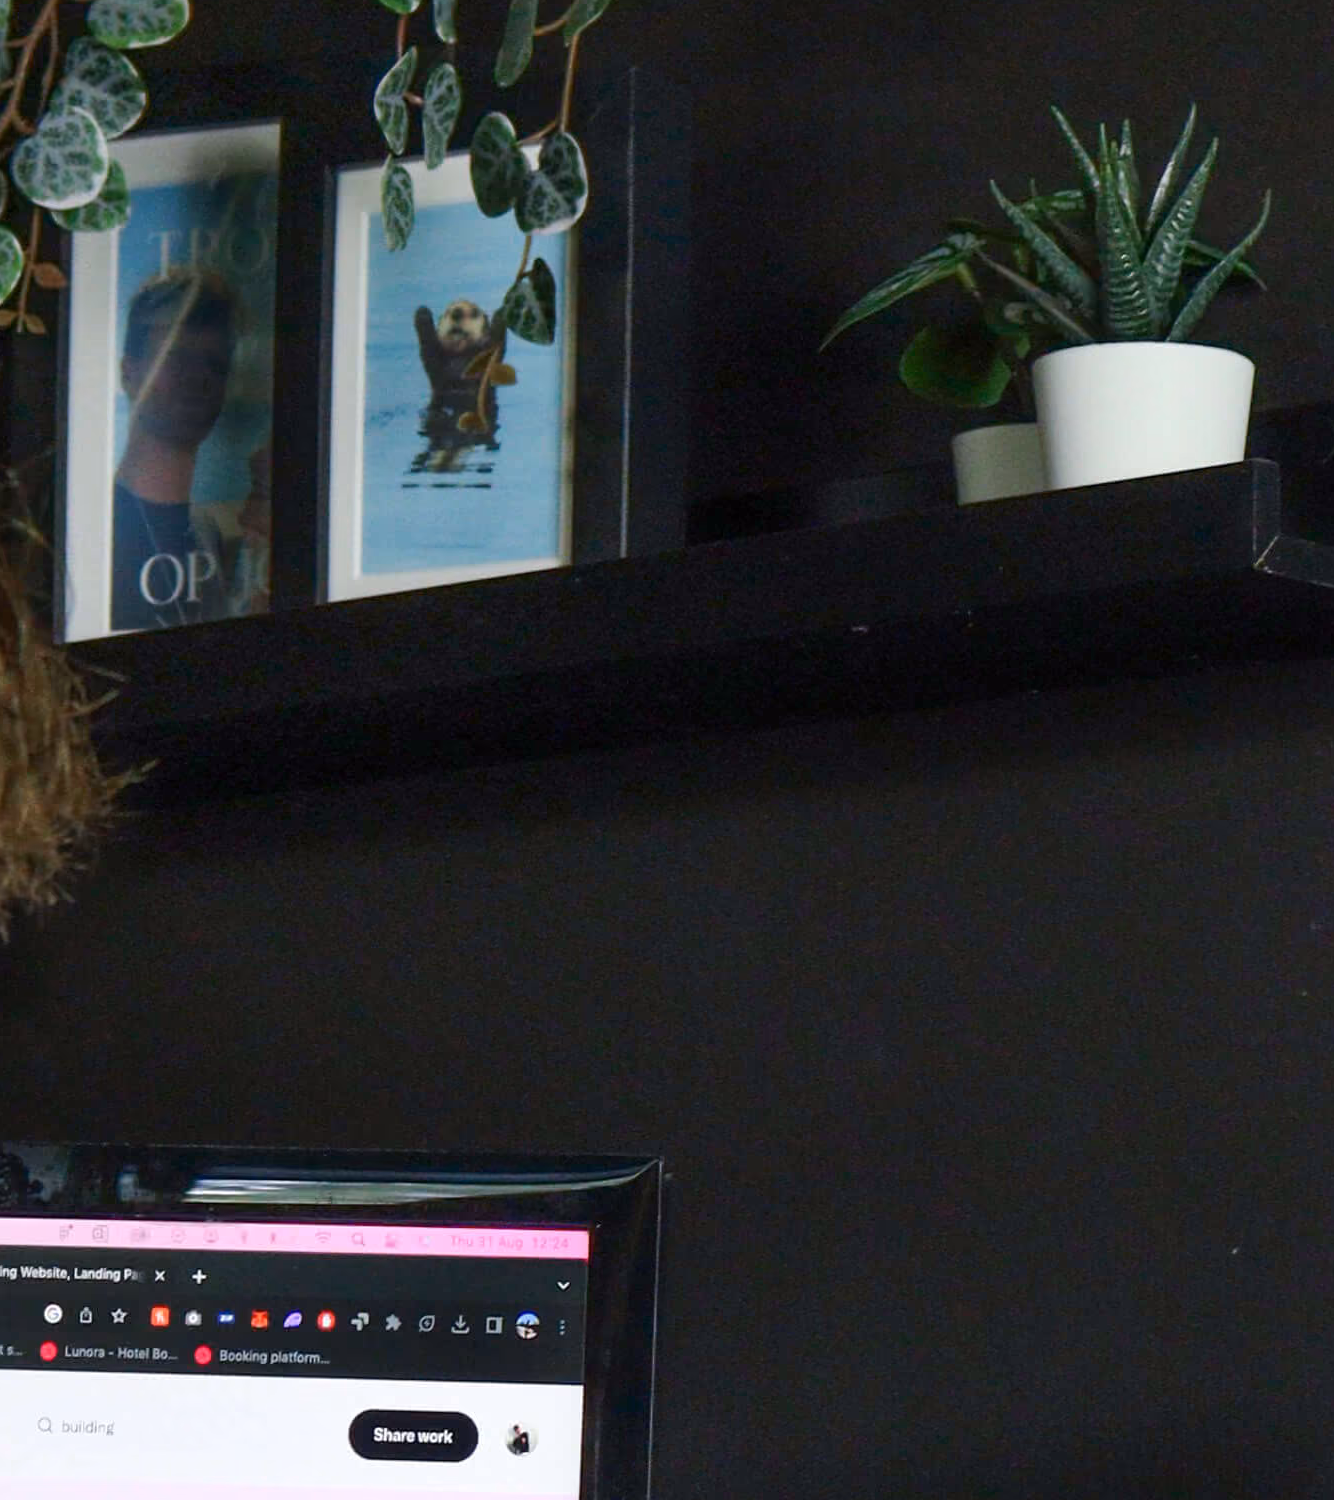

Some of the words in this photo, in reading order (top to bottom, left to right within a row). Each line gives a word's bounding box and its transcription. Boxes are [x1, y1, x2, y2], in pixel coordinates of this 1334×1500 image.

[451, 1235, 474, 1248] Thu
[478, 1236, 492, 1248] 31
[499, 1237, 524, 1251] Aug
[532, 1236, 569, 1250] 12:24
[20, 1265, 70, 1282] Website,
[74, 1267, 120, 1284] Landing
[118, 1347, 149, 1360] Hotel
[219, 1349, 268, 1366] Booking
[61, 1418, 115, 1437] building
[373, 1427, 413, 1444] Share
[417, 1429, 453, 1446] work
